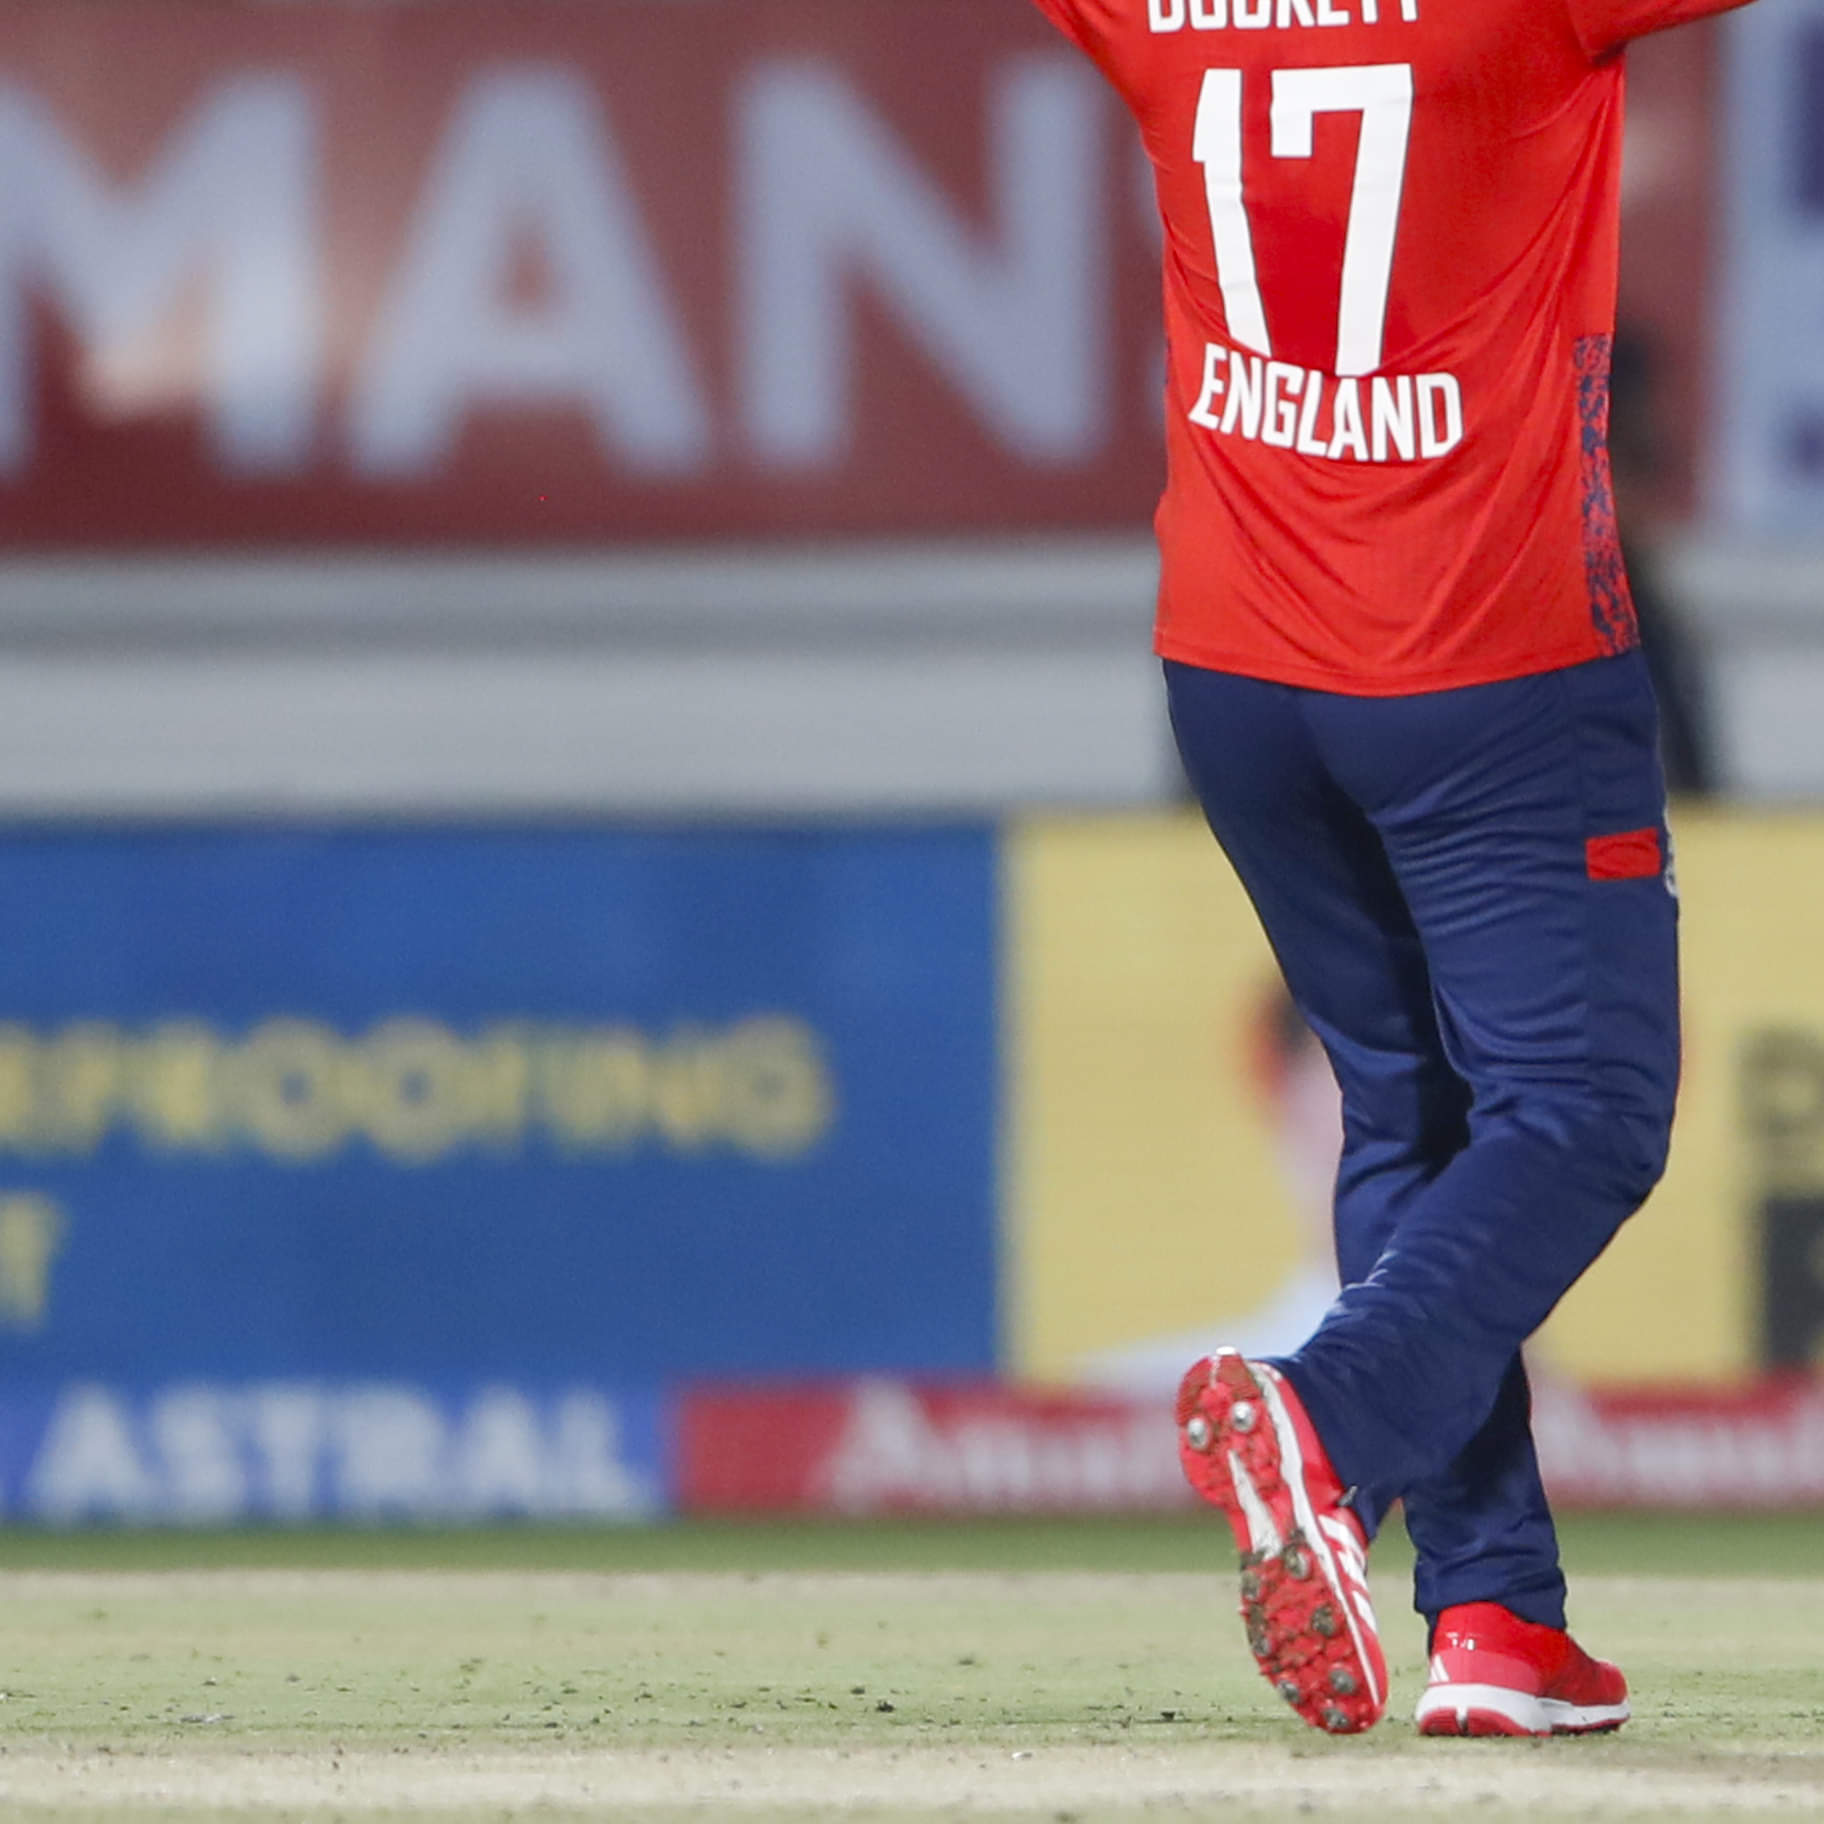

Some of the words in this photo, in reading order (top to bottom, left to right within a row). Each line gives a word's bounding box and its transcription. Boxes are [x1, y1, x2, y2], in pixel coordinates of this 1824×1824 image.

[0, 56, 1165, 476] MAN
[1191, 62, 1414, 377] 17
[1188, 343, 1464, 462] ENGLAND
[30, 1381, 655, 1519] ASTRAL
